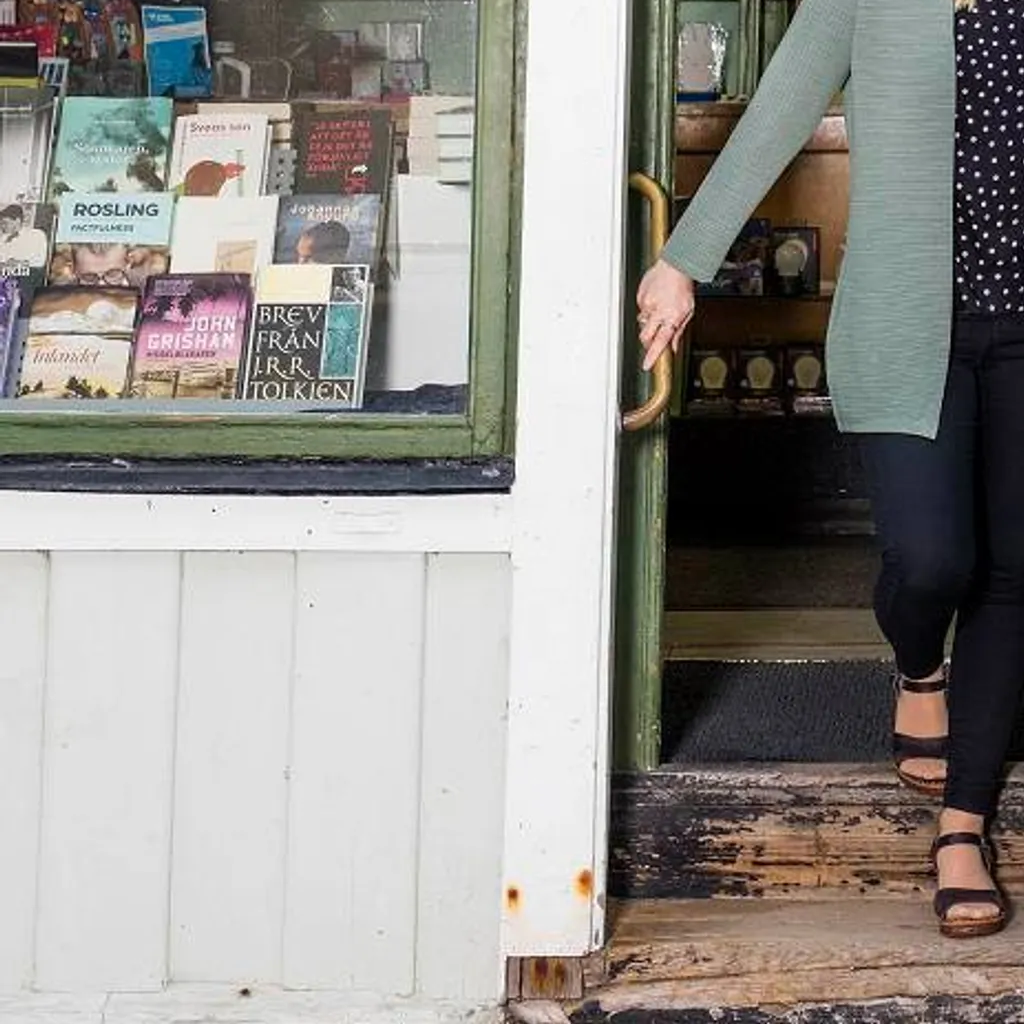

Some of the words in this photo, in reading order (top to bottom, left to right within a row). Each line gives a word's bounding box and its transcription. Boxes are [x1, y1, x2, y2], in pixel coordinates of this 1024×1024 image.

[73, 203, 159, 217] ROSLING
[184, 316, 236, 332] JOHN
[259, 305, 323, 328] BREV
[256, 328, 321, 353] FRÅN
[252, 356, 316, 380] J.R.R.
[250, 381, 351, 401] TOLKIEN
